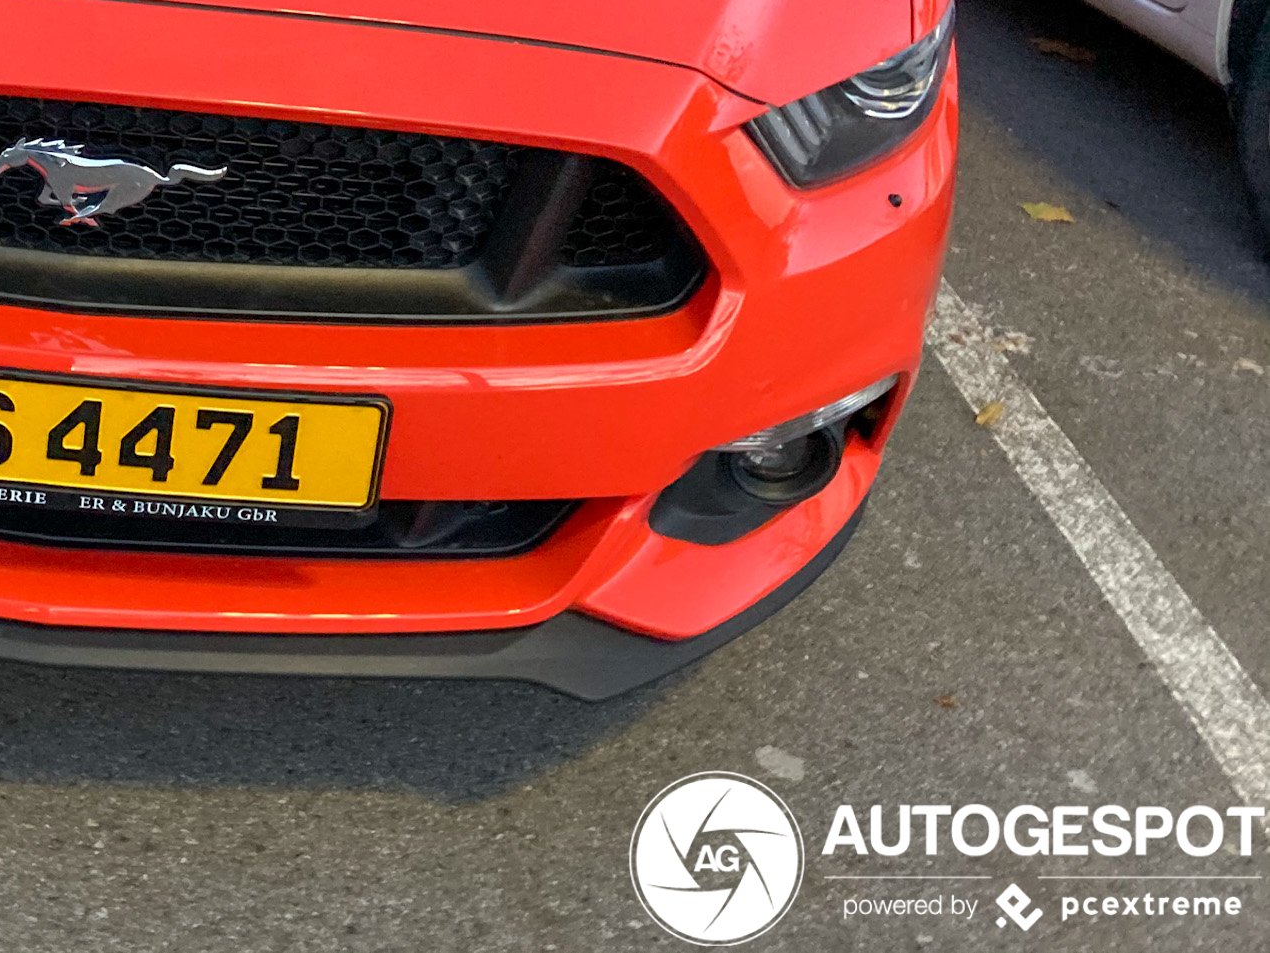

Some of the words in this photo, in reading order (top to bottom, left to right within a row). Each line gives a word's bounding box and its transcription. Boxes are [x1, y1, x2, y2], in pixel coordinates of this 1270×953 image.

[46, 398, 300, 491] 4471
[79, 496, 105, 510] ER
[111, 499, 127, 513] &
[132, 500, 231, 519] BUNJAKU
[237, 507, 278, 522] GbR
